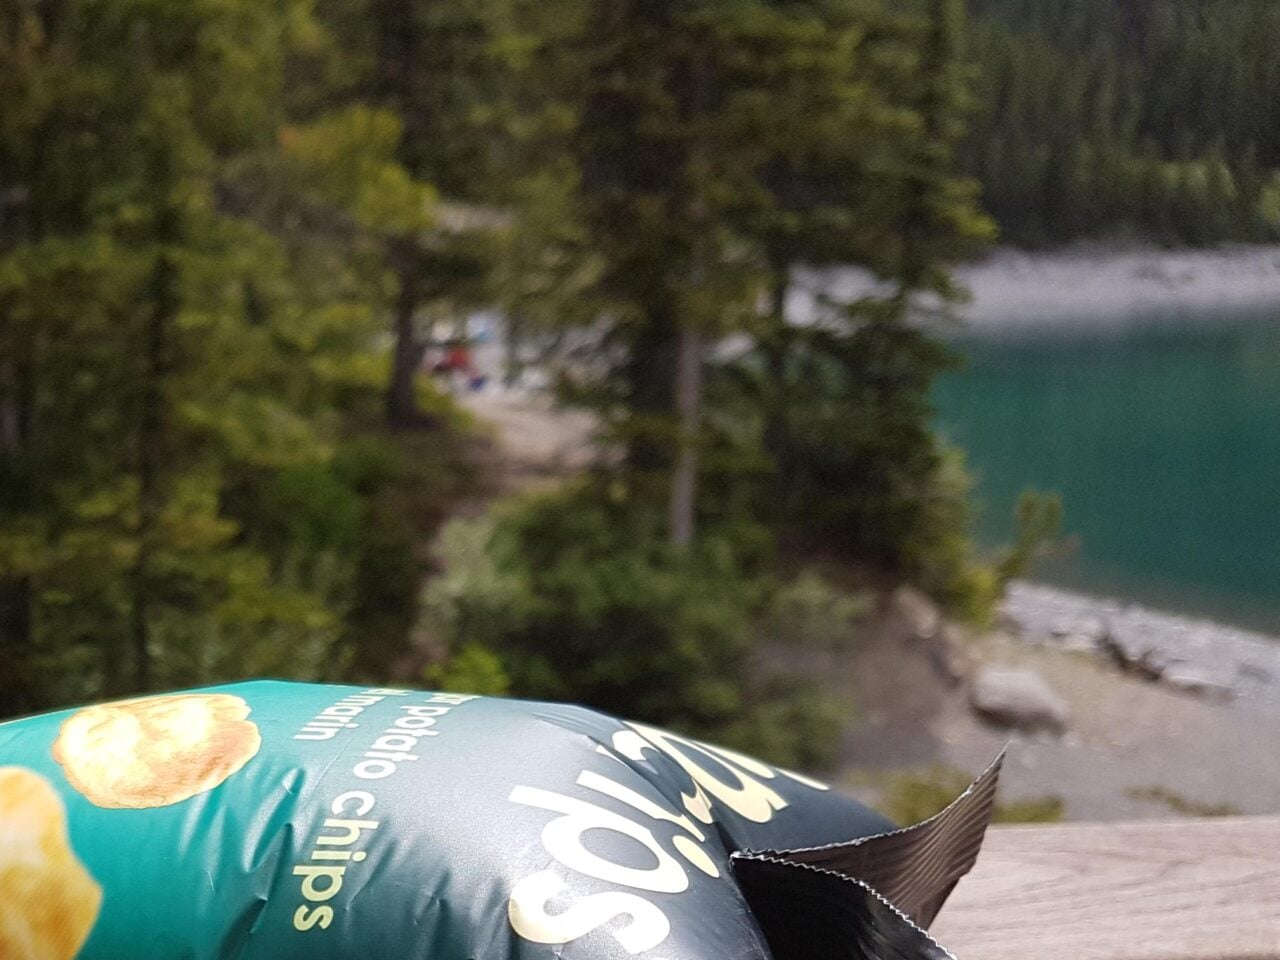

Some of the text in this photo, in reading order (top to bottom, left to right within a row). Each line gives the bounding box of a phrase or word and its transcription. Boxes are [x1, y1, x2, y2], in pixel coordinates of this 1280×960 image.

[293, 694, 386, 741] marin
[352, 705, 454, 779] potato
[292, 790, 380, 932] chips
